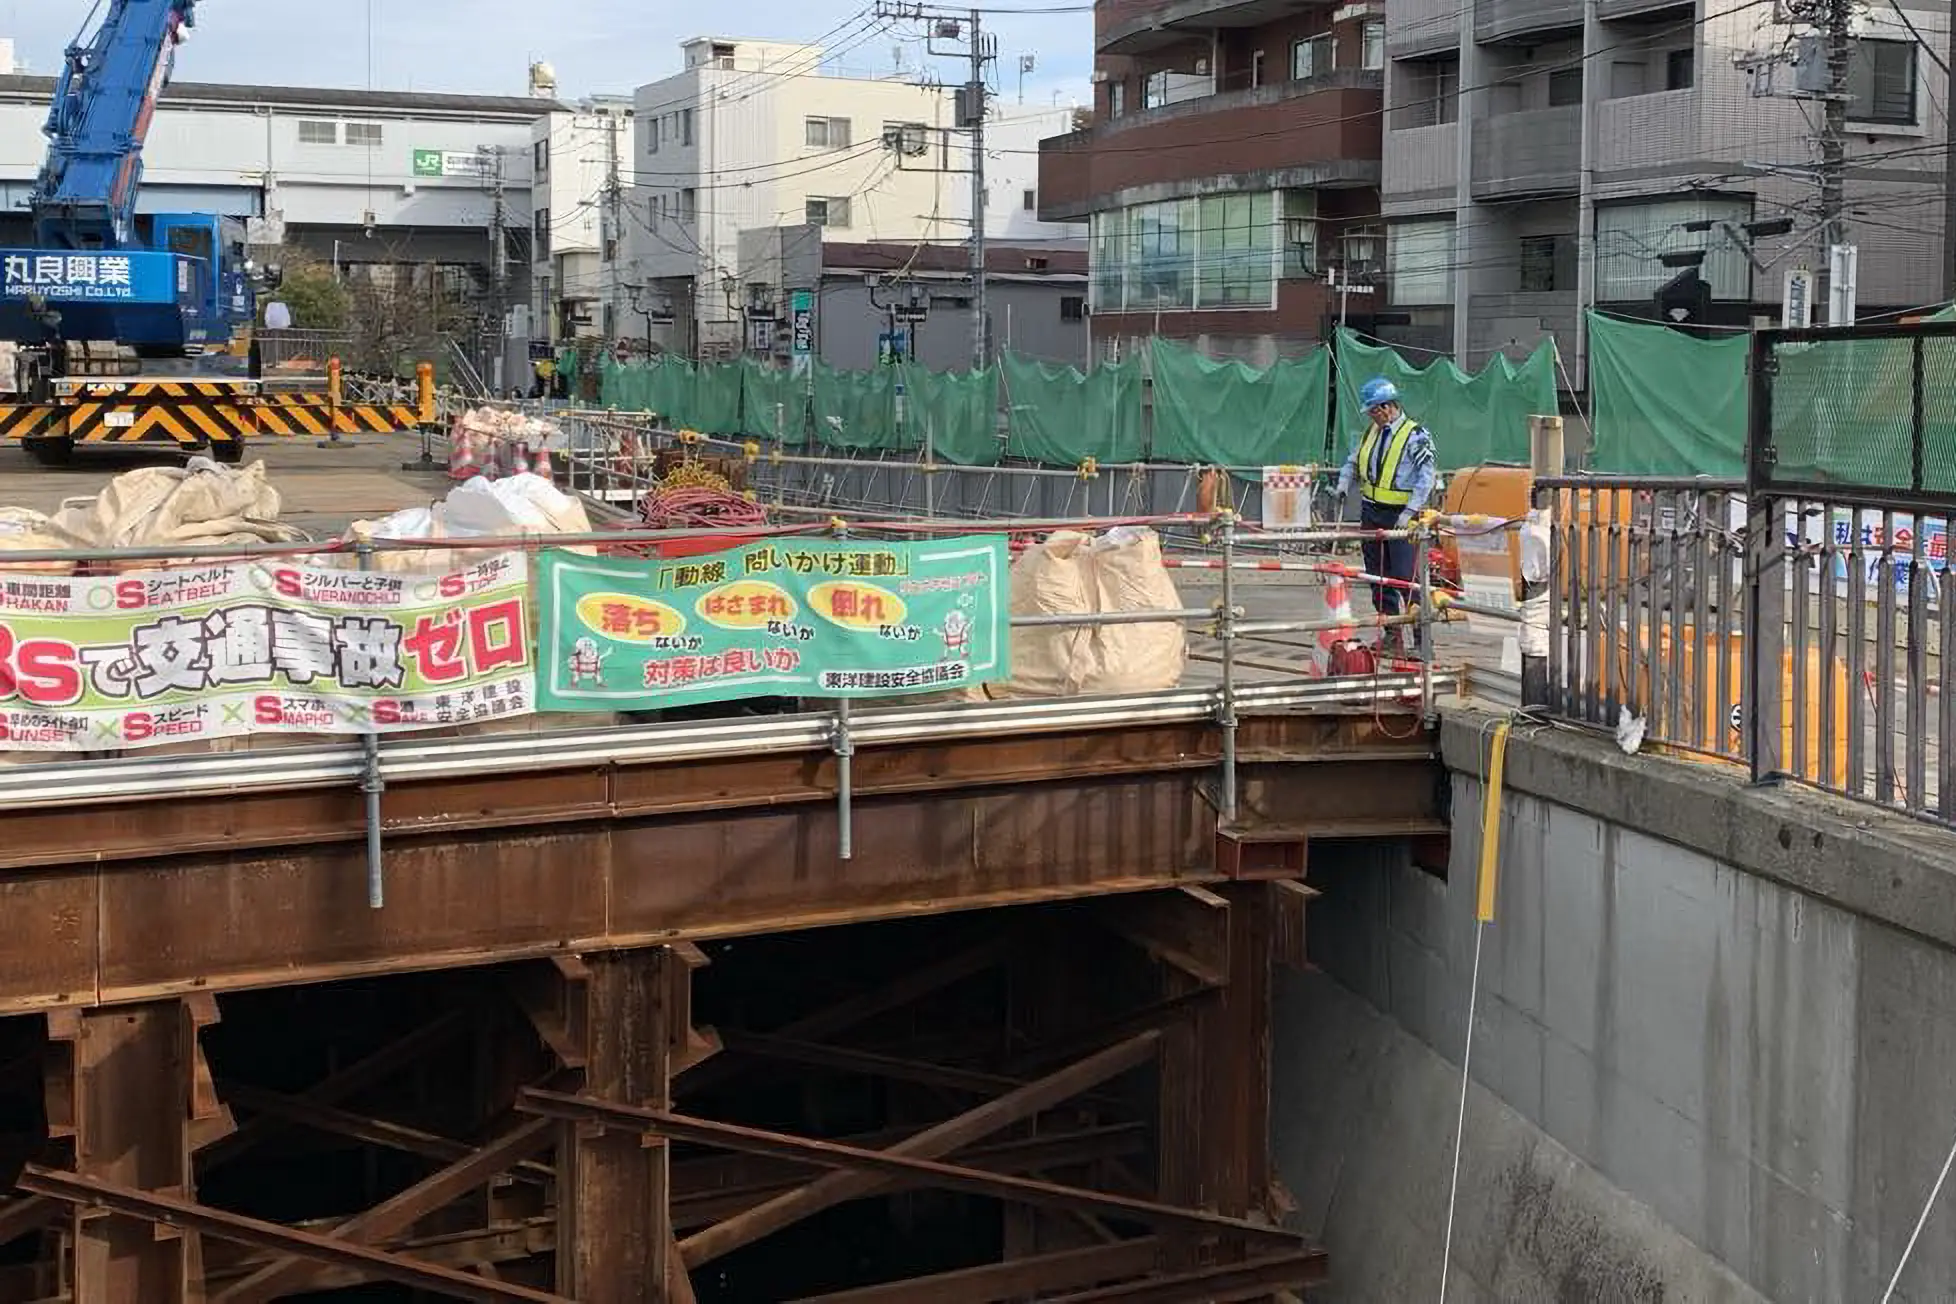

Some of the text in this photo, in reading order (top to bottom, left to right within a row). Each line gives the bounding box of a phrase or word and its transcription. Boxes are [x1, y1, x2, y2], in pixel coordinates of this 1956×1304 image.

[416, 154, 441, 170] JR
[5, 255, 129, 284] 丸良興業
[148, 565, 234, 592] シートベルト
[704, 594, 790, 616] はさまれ
[602, 603, 661, 636] 落ち
[767, 620, 815, 641] ないか
[879, 624, 922, 641] ないか
[655, 636, 702, 649] ないか
[646, 648, 800, 684] 対策は良いか
[154, 704, 208, 724] スピード
